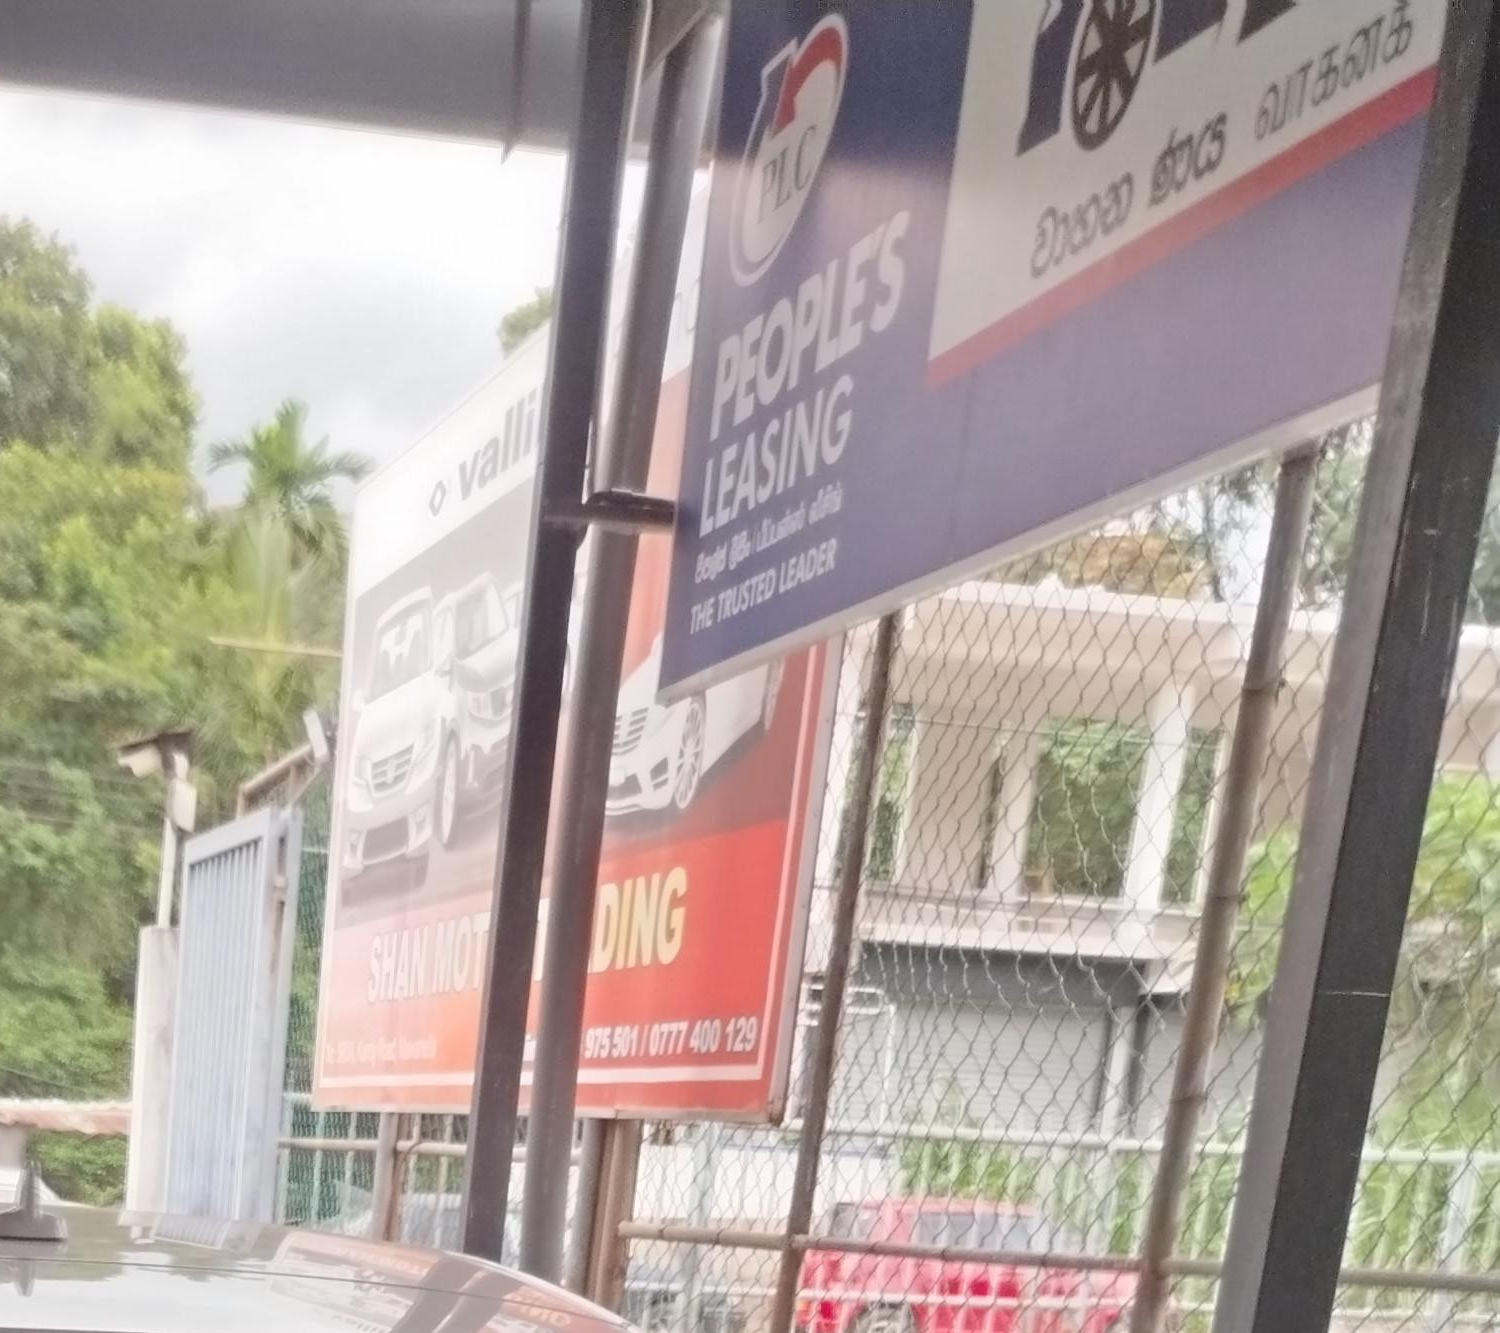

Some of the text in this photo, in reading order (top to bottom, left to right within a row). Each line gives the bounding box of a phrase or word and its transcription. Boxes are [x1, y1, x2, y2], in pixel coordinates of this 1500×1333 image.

[757, 124, 819, 224] PLC
[710, 210, 910, 441] PEOPLE'S
[458, 387, 538, 501] valli
[699, 374, 854, 539] LEASING
[689, 596, 716, 635] THE
[716, 567, 778, 623] TRUSTED
[778, 537, 838, 594] LEADER
[367, 923, 426, 1004] SHAN
[431, 911, 491, 995] MOT
[649, 1021, 688, 1057] 0777
[690, 1019, 721, 1055] 400
[725, 1015, 758, 1054] 129
